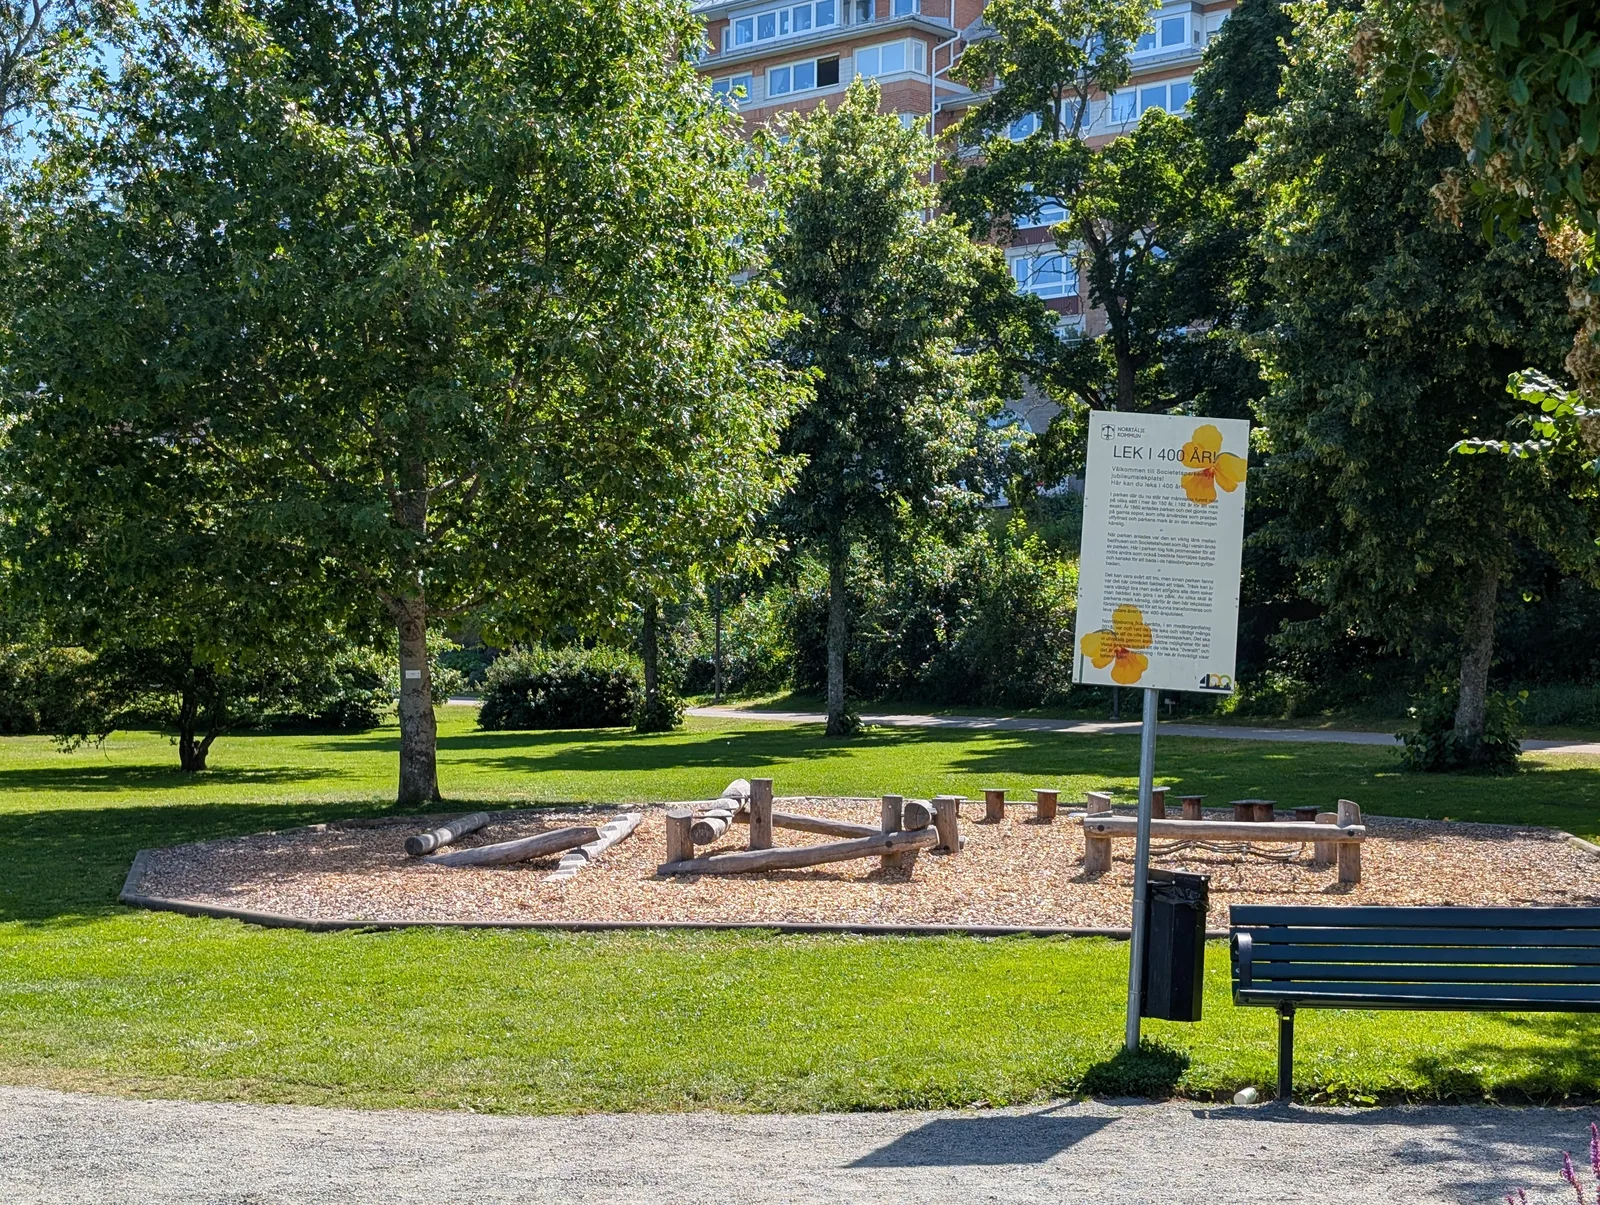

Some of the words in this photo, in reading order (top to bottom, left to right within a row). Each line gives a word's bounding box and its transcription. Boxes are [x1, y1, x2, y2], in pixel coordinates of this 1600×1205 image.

[1113, 445, 1143, 459] LEK
[1149, 447, 1152, 460] I
[1157, 448, 1185, 462] 400
[1190, 446, 1217, 464] ÅR!
